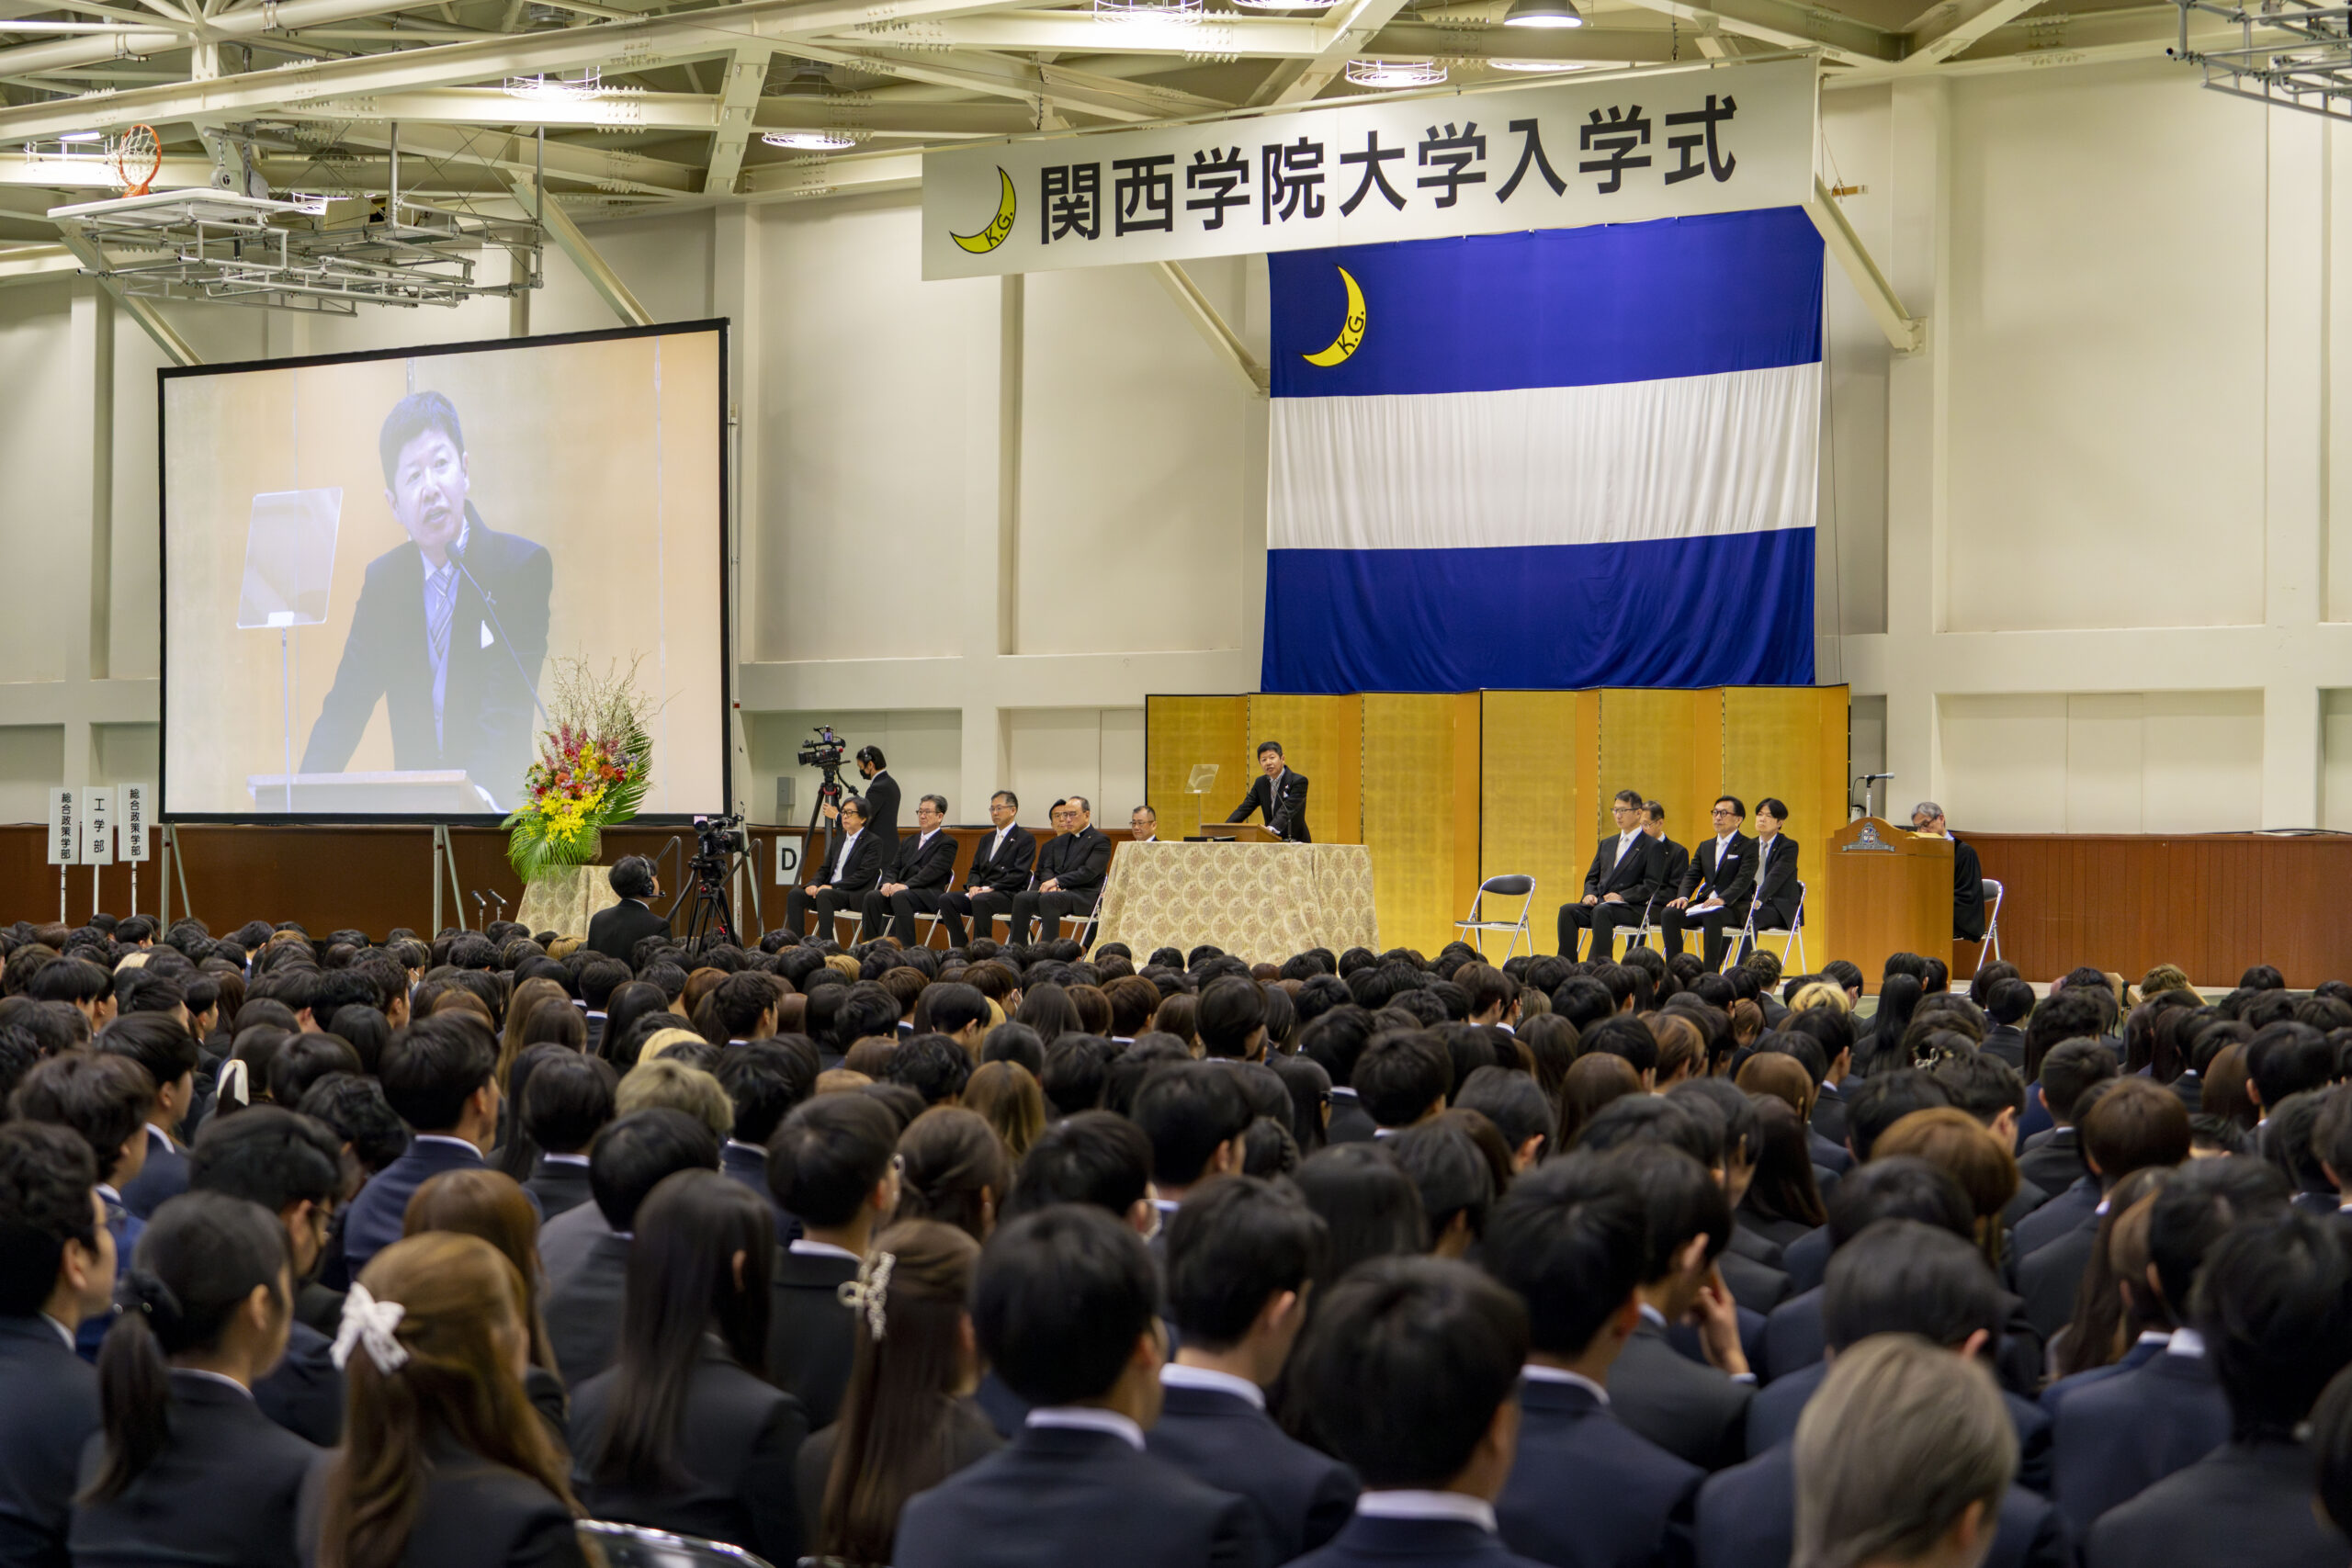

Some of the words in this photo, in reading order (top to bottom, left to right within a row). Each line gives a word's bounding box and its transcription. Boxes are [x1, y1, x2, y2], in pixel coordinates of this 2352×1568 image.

[1040, 94, 1737, 245] 関西学院大学入学式
[984, 211, 1013, 248] K.G.
[1337, 310, 1364, 356] K.G.
[61, 792, 72, 860] 総合政策学部
[94, 797, 106, 853] 工学部
[130, 788, 141, 856] 総合政策学部
[781, 847, 797, 871] D
